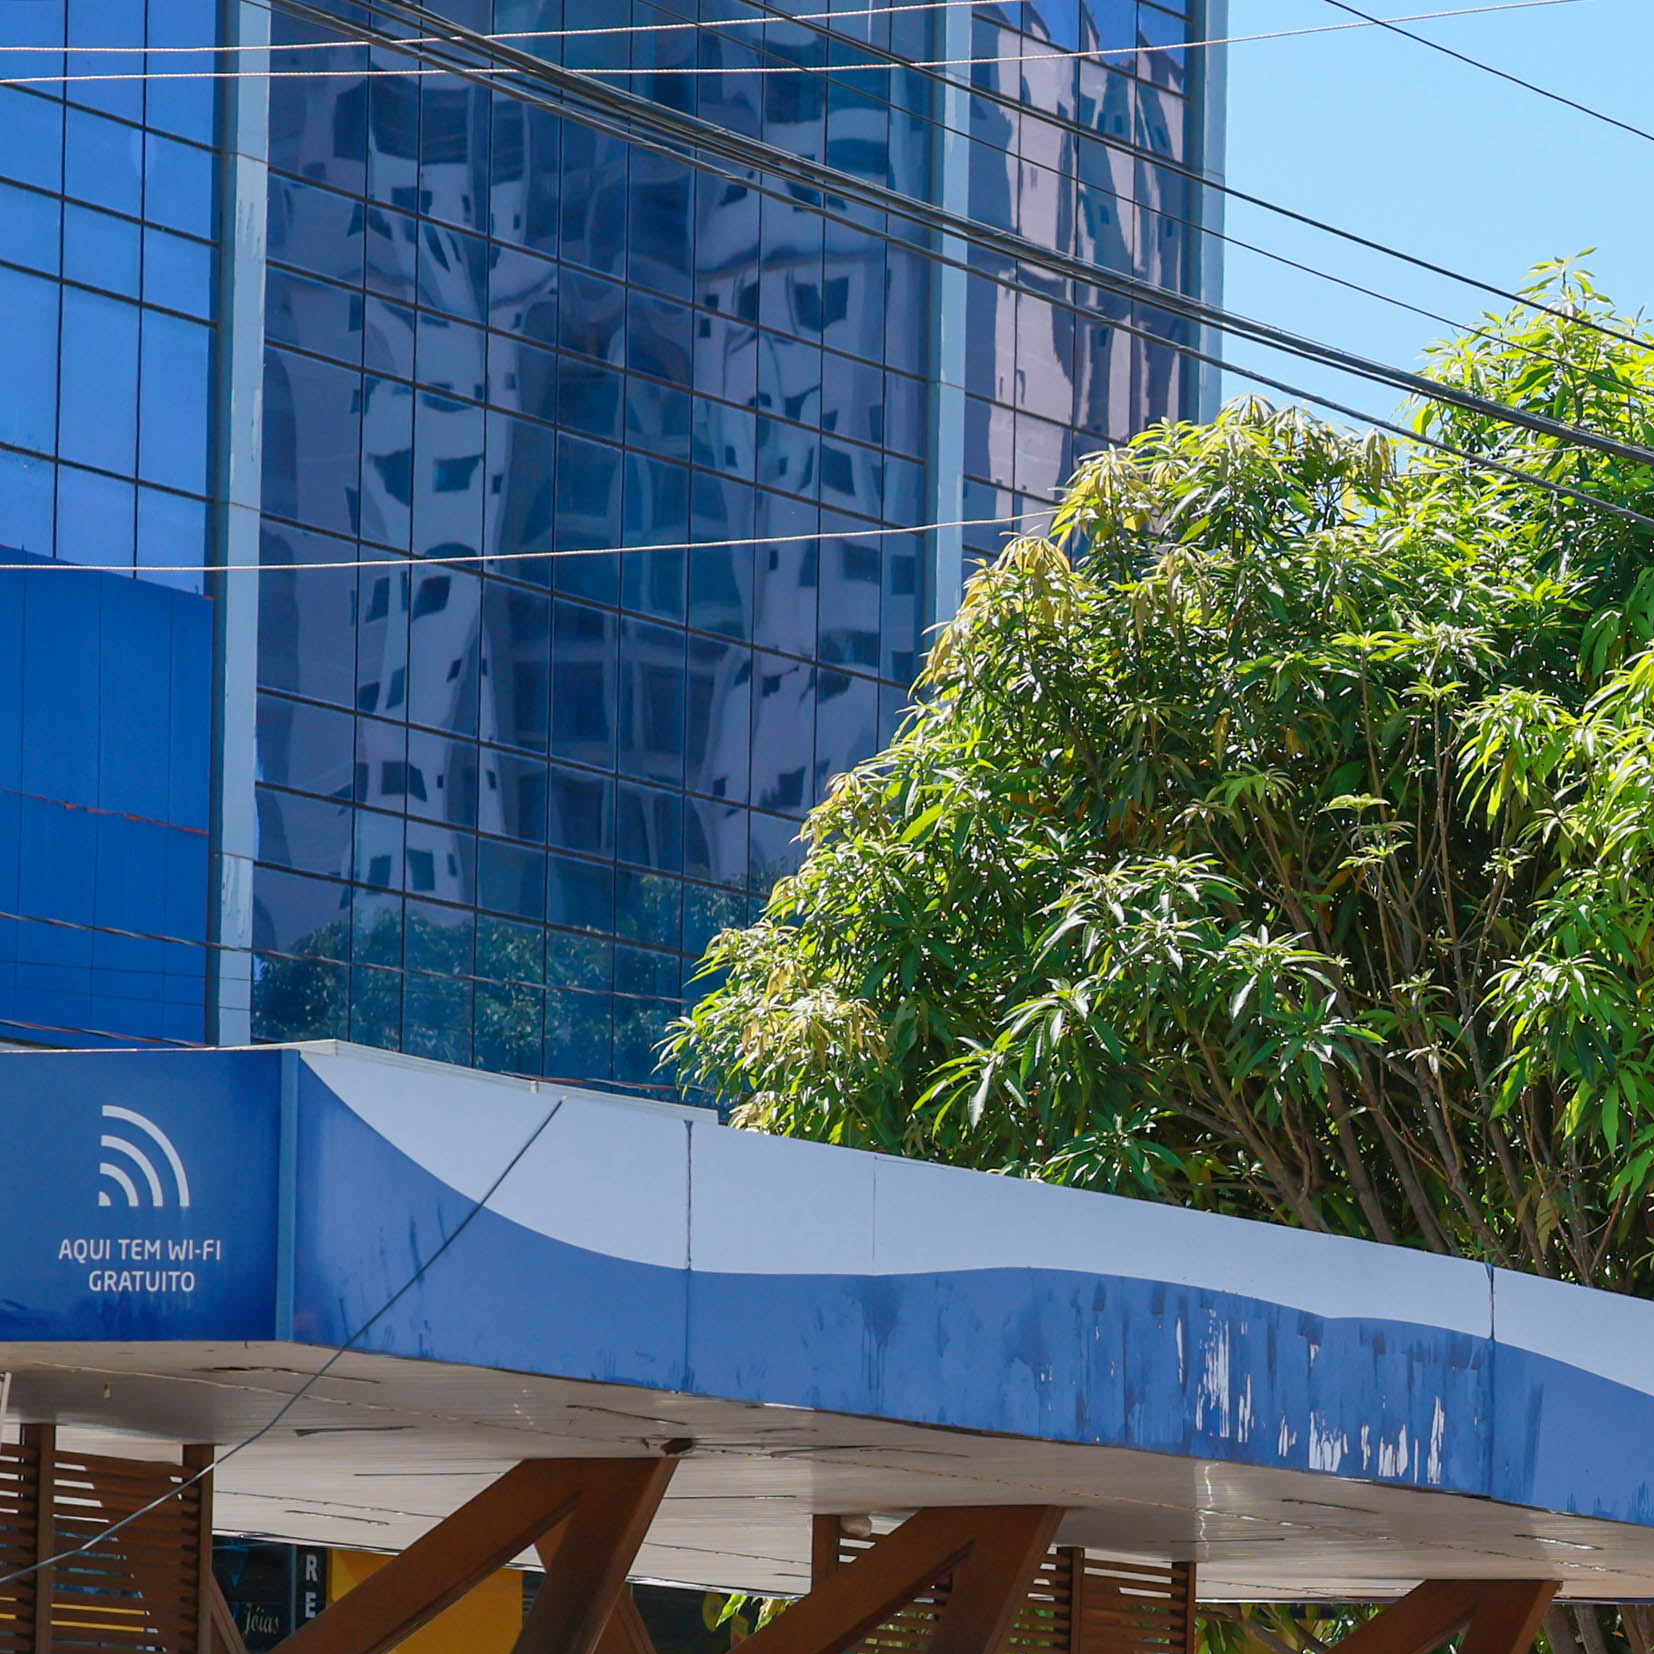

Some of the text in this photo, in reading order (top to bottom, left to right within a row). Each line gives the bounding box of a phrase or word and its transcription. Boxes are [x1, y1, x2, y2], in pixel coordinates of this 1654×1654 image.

[58, 1238, 221, 1263] AQUI TEM WI-FI
[88, 1270, 195, 1292] GRATUITO
